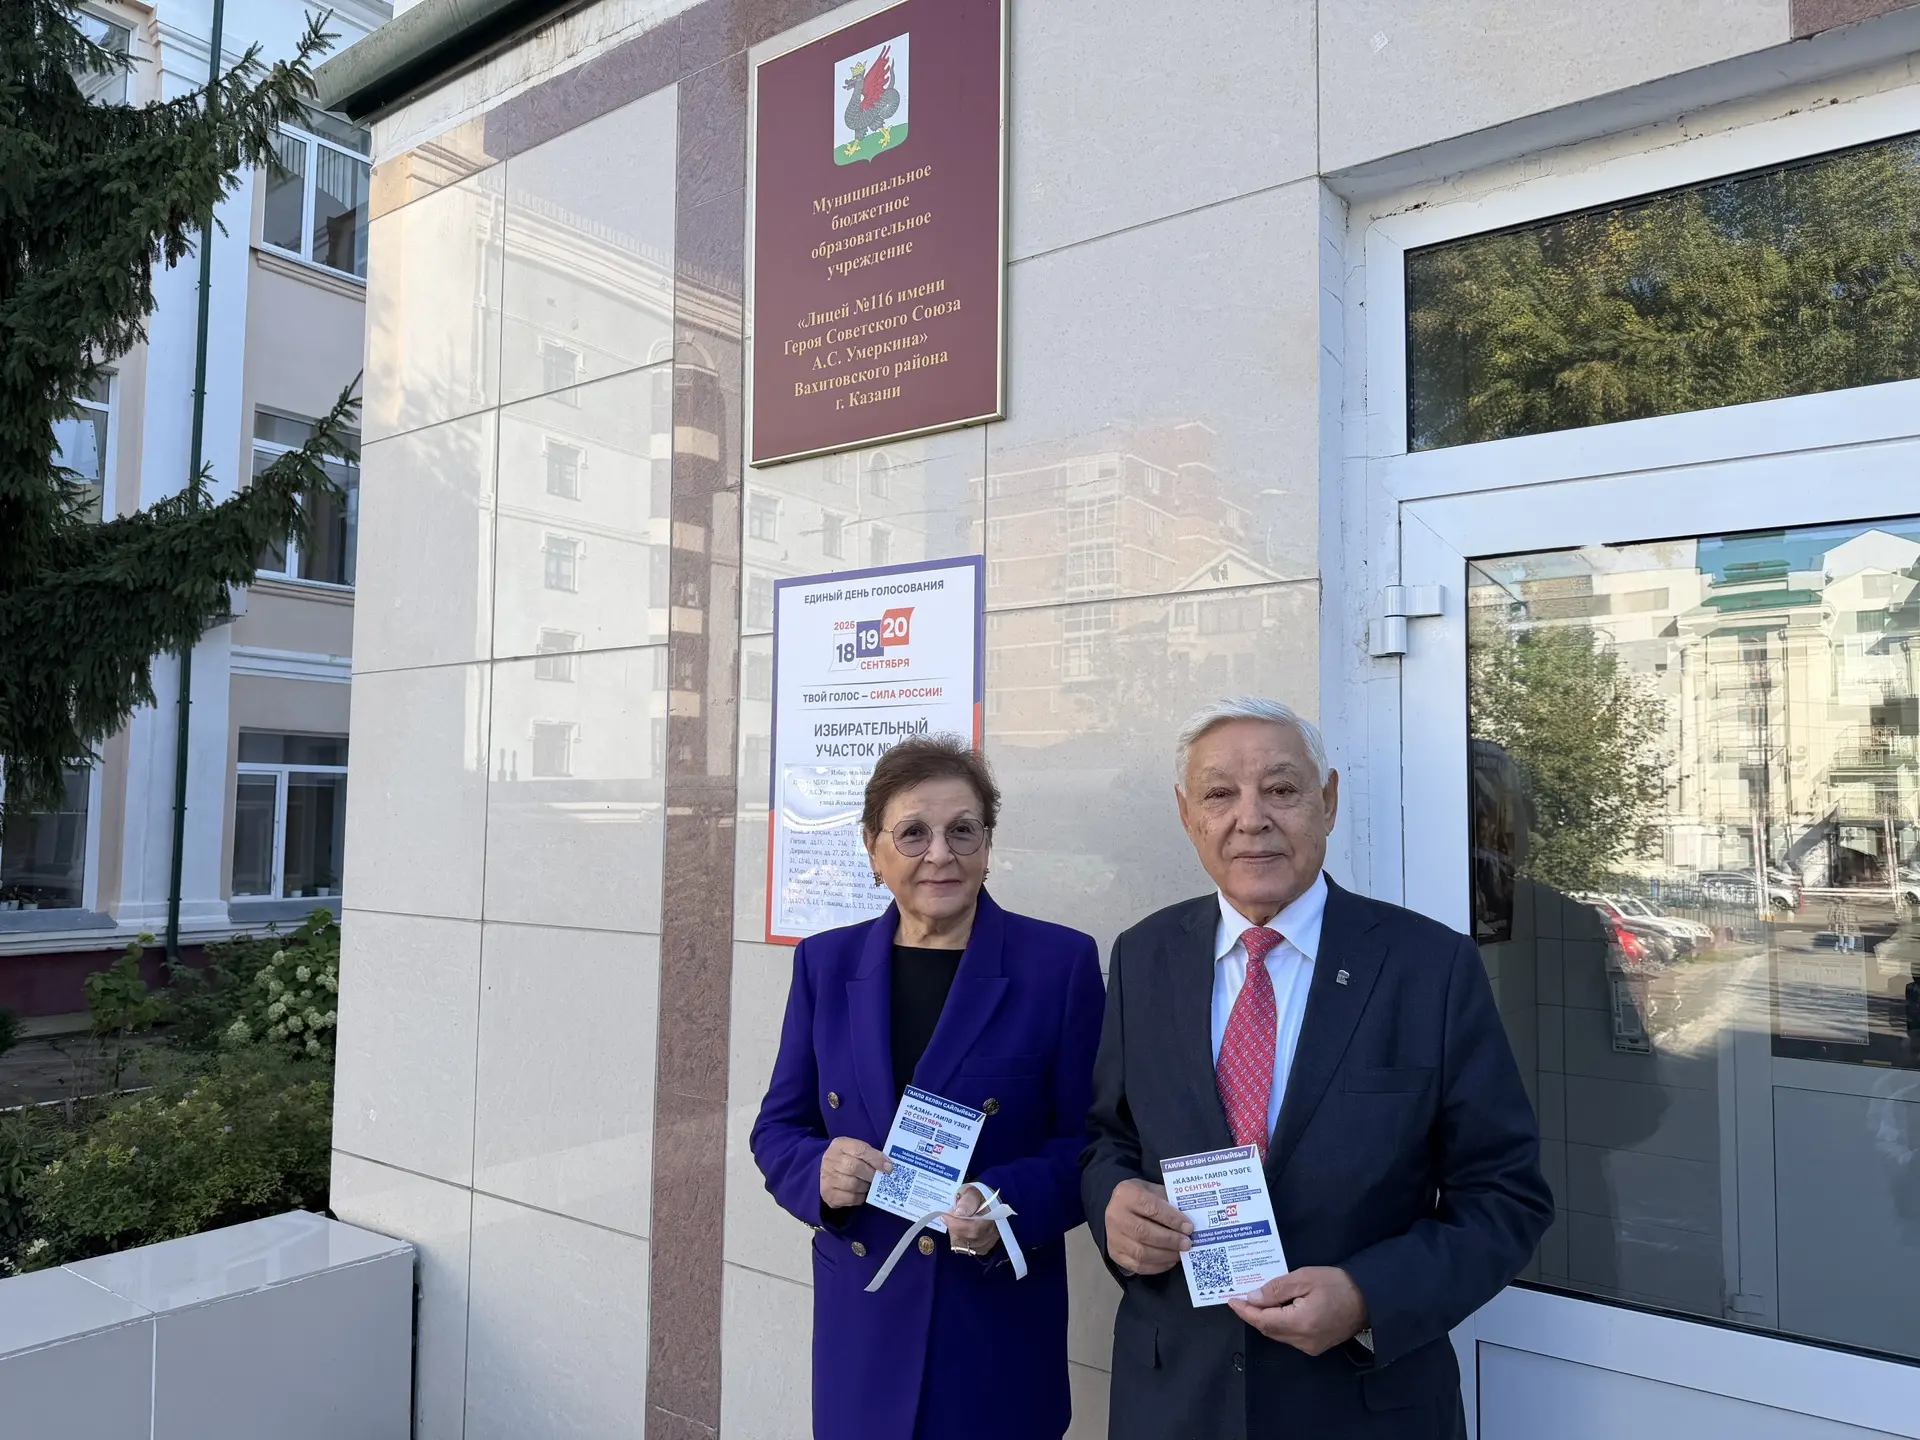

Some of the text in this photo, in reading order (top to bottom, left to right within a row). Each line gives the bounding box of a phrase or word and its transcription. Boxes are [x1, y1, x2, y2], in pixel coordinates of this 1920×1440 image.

[812, 163, 932, 216] Муниципальное
[832, 194, 910, 230] бюджетное
[811, 211, 931, 260] образовательное
[827, 239, 913, 280] учреждение
[797, 277, 946, 331] «Лицей №116 имени
[784, 298, 961, 356] Героя Советского Союза
[812, 332, 928, 371] А.С. Умеркина»
[794, 348, 948, 397] Вахитовского района
[836, 386, 901, 410] г. Казани
[804, 580, 944, 604] ЕДИНЫЙ ДЕНЬ ГОЛОСОВАНИЯ
[834, 621, 855, 630] 2026
[883, 616, 907, 638] 20
[859, 629, 878, 650] 19
[836, 643, 854, 663] 18
[860, 658, 909, 670] СЕНТЯБРЯ
[803, 691, 827, 703] ТВОЙ
[829, 692, 859, 701] ГОЛОС
[870, 690, 896, 700] СИЛА
[899, 687, 942, 698] РОССИИ!
[814, 717, 928, 737] ИЗБИРАТЕЛЬНЫЙ
[816, 743, 874, 757] УЧАСТОК
[1184, 1182, 1221, 1192] СЕНТЯБРЬ
